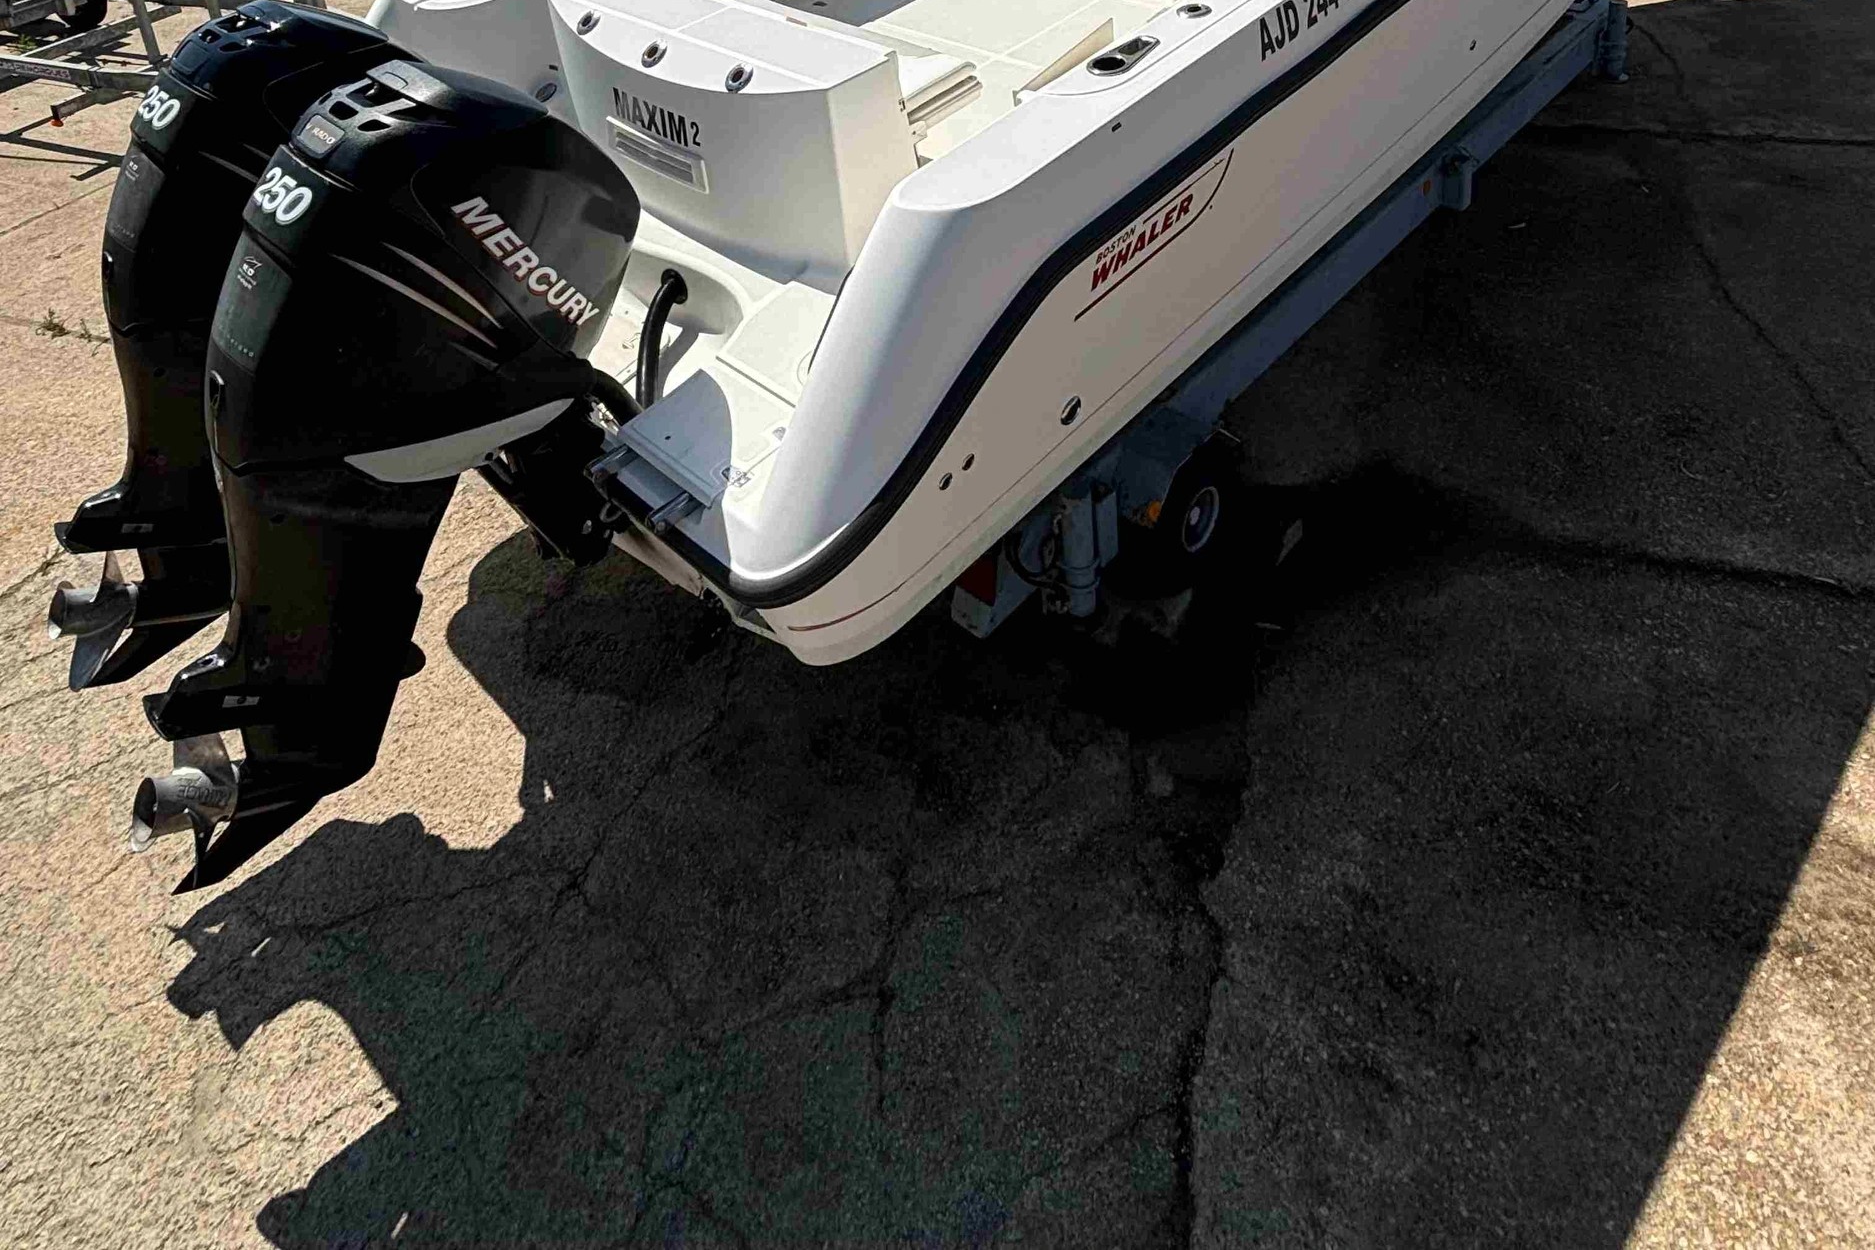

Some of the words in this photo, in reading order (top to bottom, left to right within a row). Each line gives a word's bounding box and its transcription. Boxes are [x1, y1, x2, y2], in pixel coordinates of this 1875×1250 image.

[1259, 0, 1300, 62] AJD
[138, 85, 181, 131] 250
[252, 166, 313, 226] 250
[450, 196, 600, 326] MERCURY
[1090, 193, 1194, 292] WHALER
[1095, 224, 1137, 265] BOSTON
